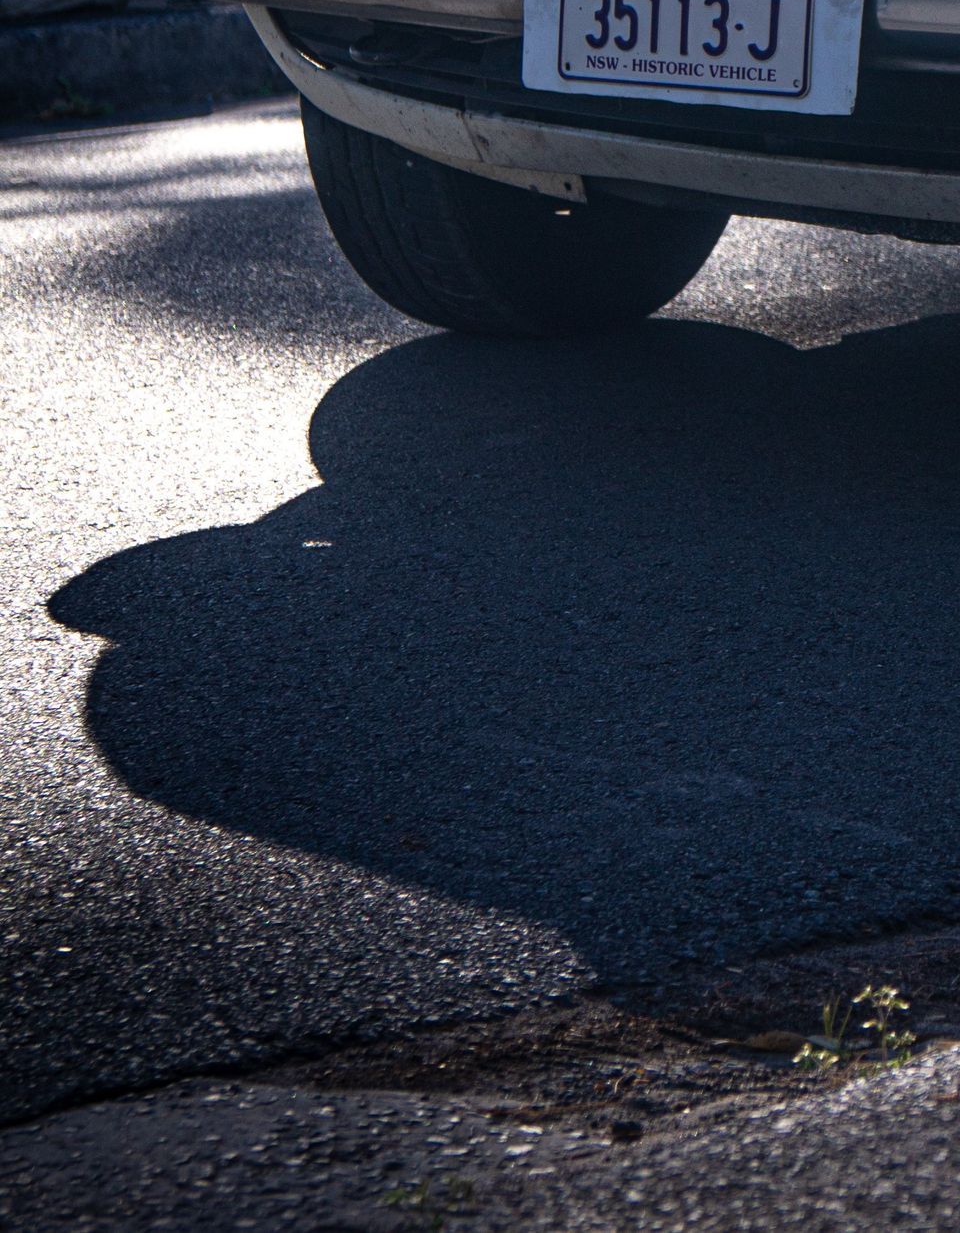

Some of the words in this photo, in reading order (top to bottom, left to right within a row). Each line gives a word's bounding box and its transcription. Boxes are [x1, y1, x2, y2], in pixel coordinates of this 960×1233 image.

[586, 54, 620, 71] NSW
[632, 58, 705, 77] HISTORIC
[708, 64, 777, 82] VEHICLE
